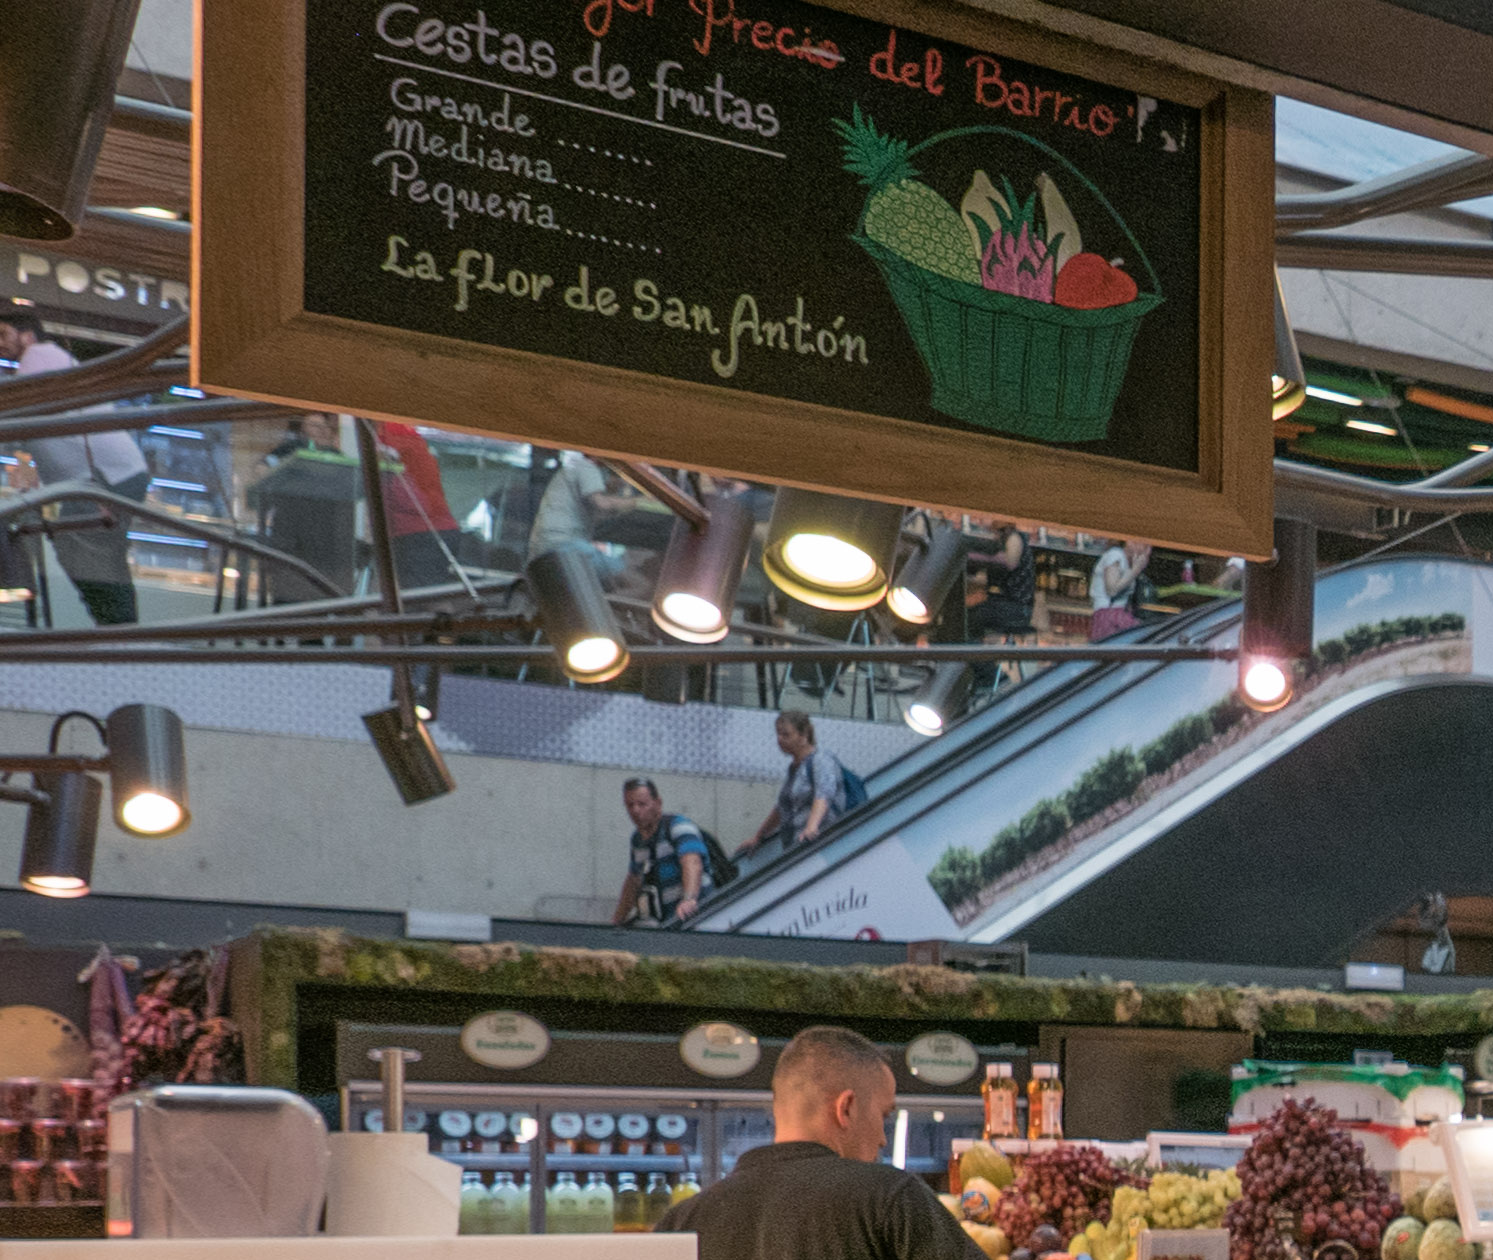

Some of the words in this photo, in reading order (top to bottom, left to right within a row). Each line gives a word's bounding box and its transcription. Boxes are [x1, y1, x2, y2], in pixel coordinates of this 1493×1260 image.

[376, 3, 558, 78] Cestas
[573, 42, 636, 99] de
[648, 61, 780, 137] frutas
[868, 28, 944, 96] del
[390, 78, 536, 136] Grande
[387, 116, 559, 185] Mediana
[372, 149, 561, 230] Pequeña
[381, 235, 443, 283] La
[564, 265, 621, 316] de
[632, 278, 719, 335] San
[712, 294, 870, 377] Antón
